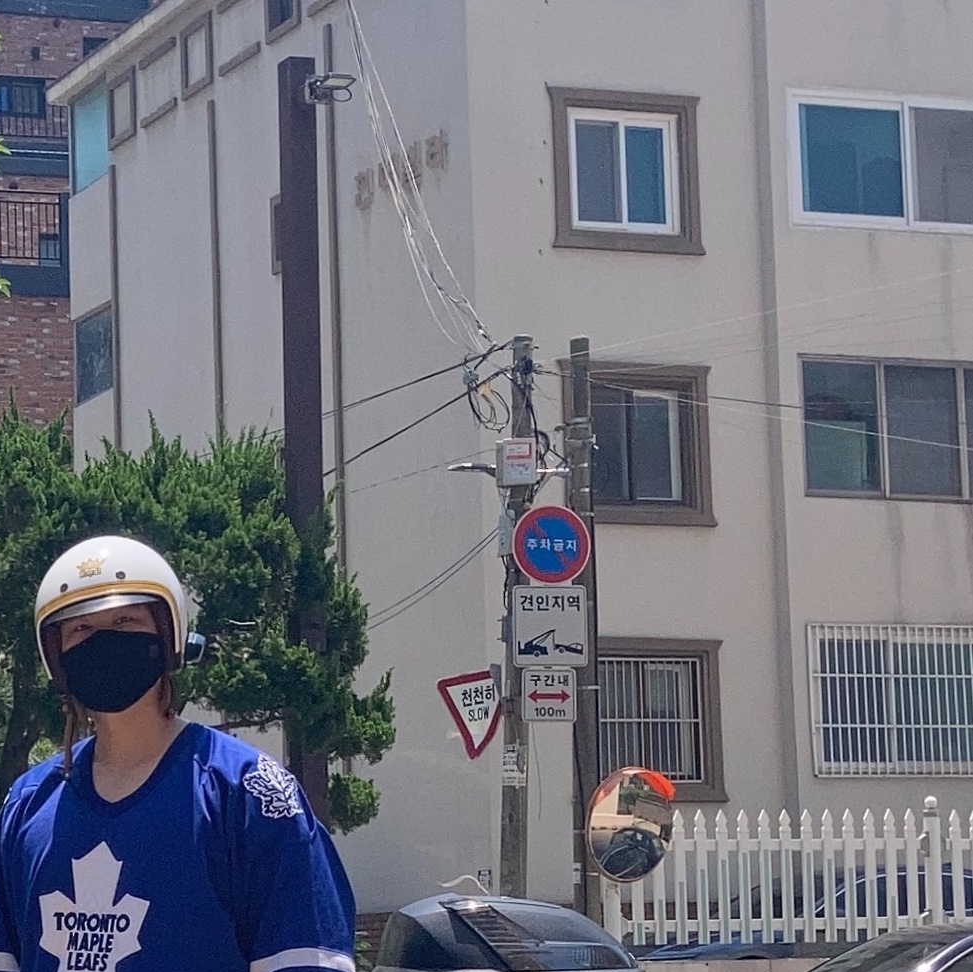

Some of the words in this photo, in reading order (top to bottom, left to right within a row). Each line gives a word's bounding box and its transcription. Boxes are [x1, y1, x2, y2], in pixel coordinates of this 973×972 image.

[527, 538, 577, 552] 주차금지
[520, 594, 580, 612] 견인지역
[529, 674, 569, 687] 구간내
[461, 683, 496, 707] 천천히
[468, 706, 490, 722] SLOW
[534, 706, 566, 717] 100m
[53, 912, 131, 933] TORONTO
[66, 932, 114, 953] MAPLE
[67, 952, 109, 972] LEAFS
